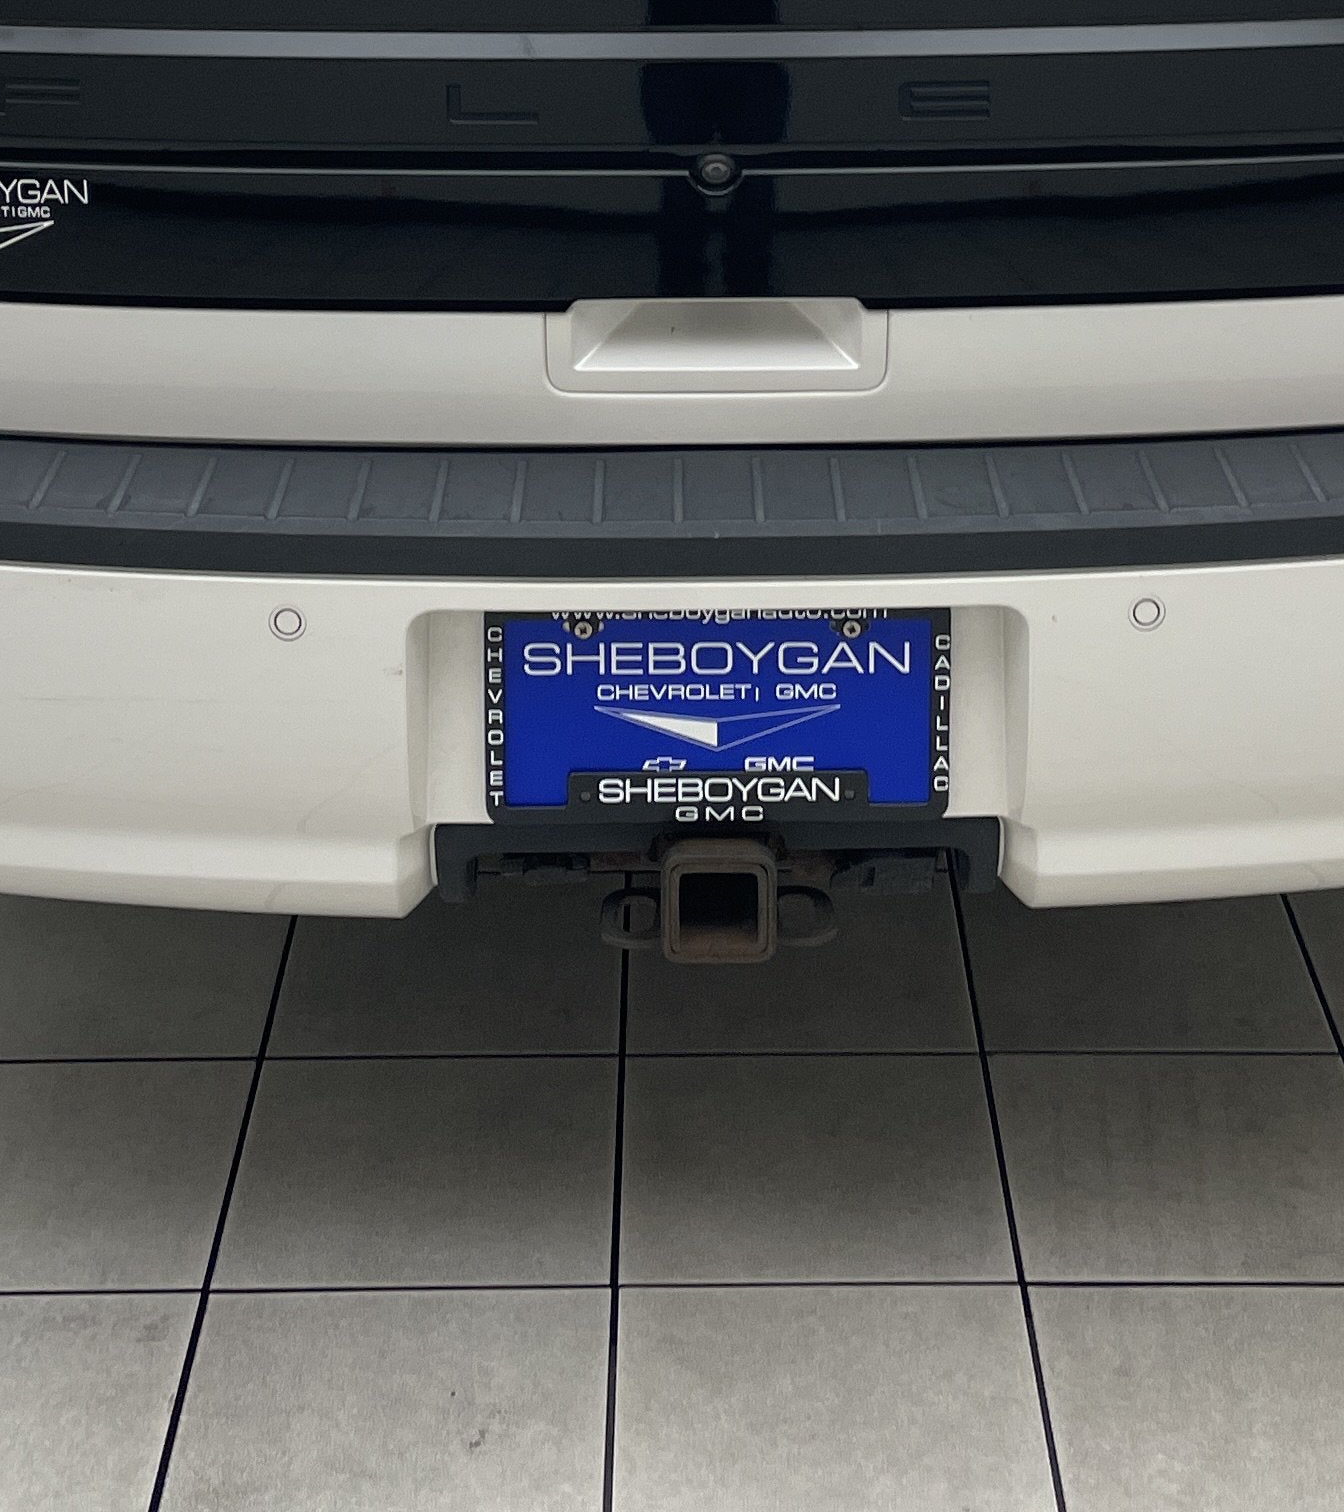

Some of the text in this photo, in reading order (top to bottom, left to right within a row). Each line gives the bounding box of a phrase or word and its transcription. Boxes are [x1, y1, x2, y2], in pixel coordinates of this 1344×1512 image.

[522, 641, 911, 676] SHEBOYGAN
[596, 682, 837, 701] CHEVROLET GMC
[487, 626, 504, 807] CHEVROLET
[933, 634, 951, 792] CADILLAC
[743, 756, 815, 772] GMC
[597, 777, 840, 805] SHEBOYGAN
[674, 806, 764, 822] GMC
